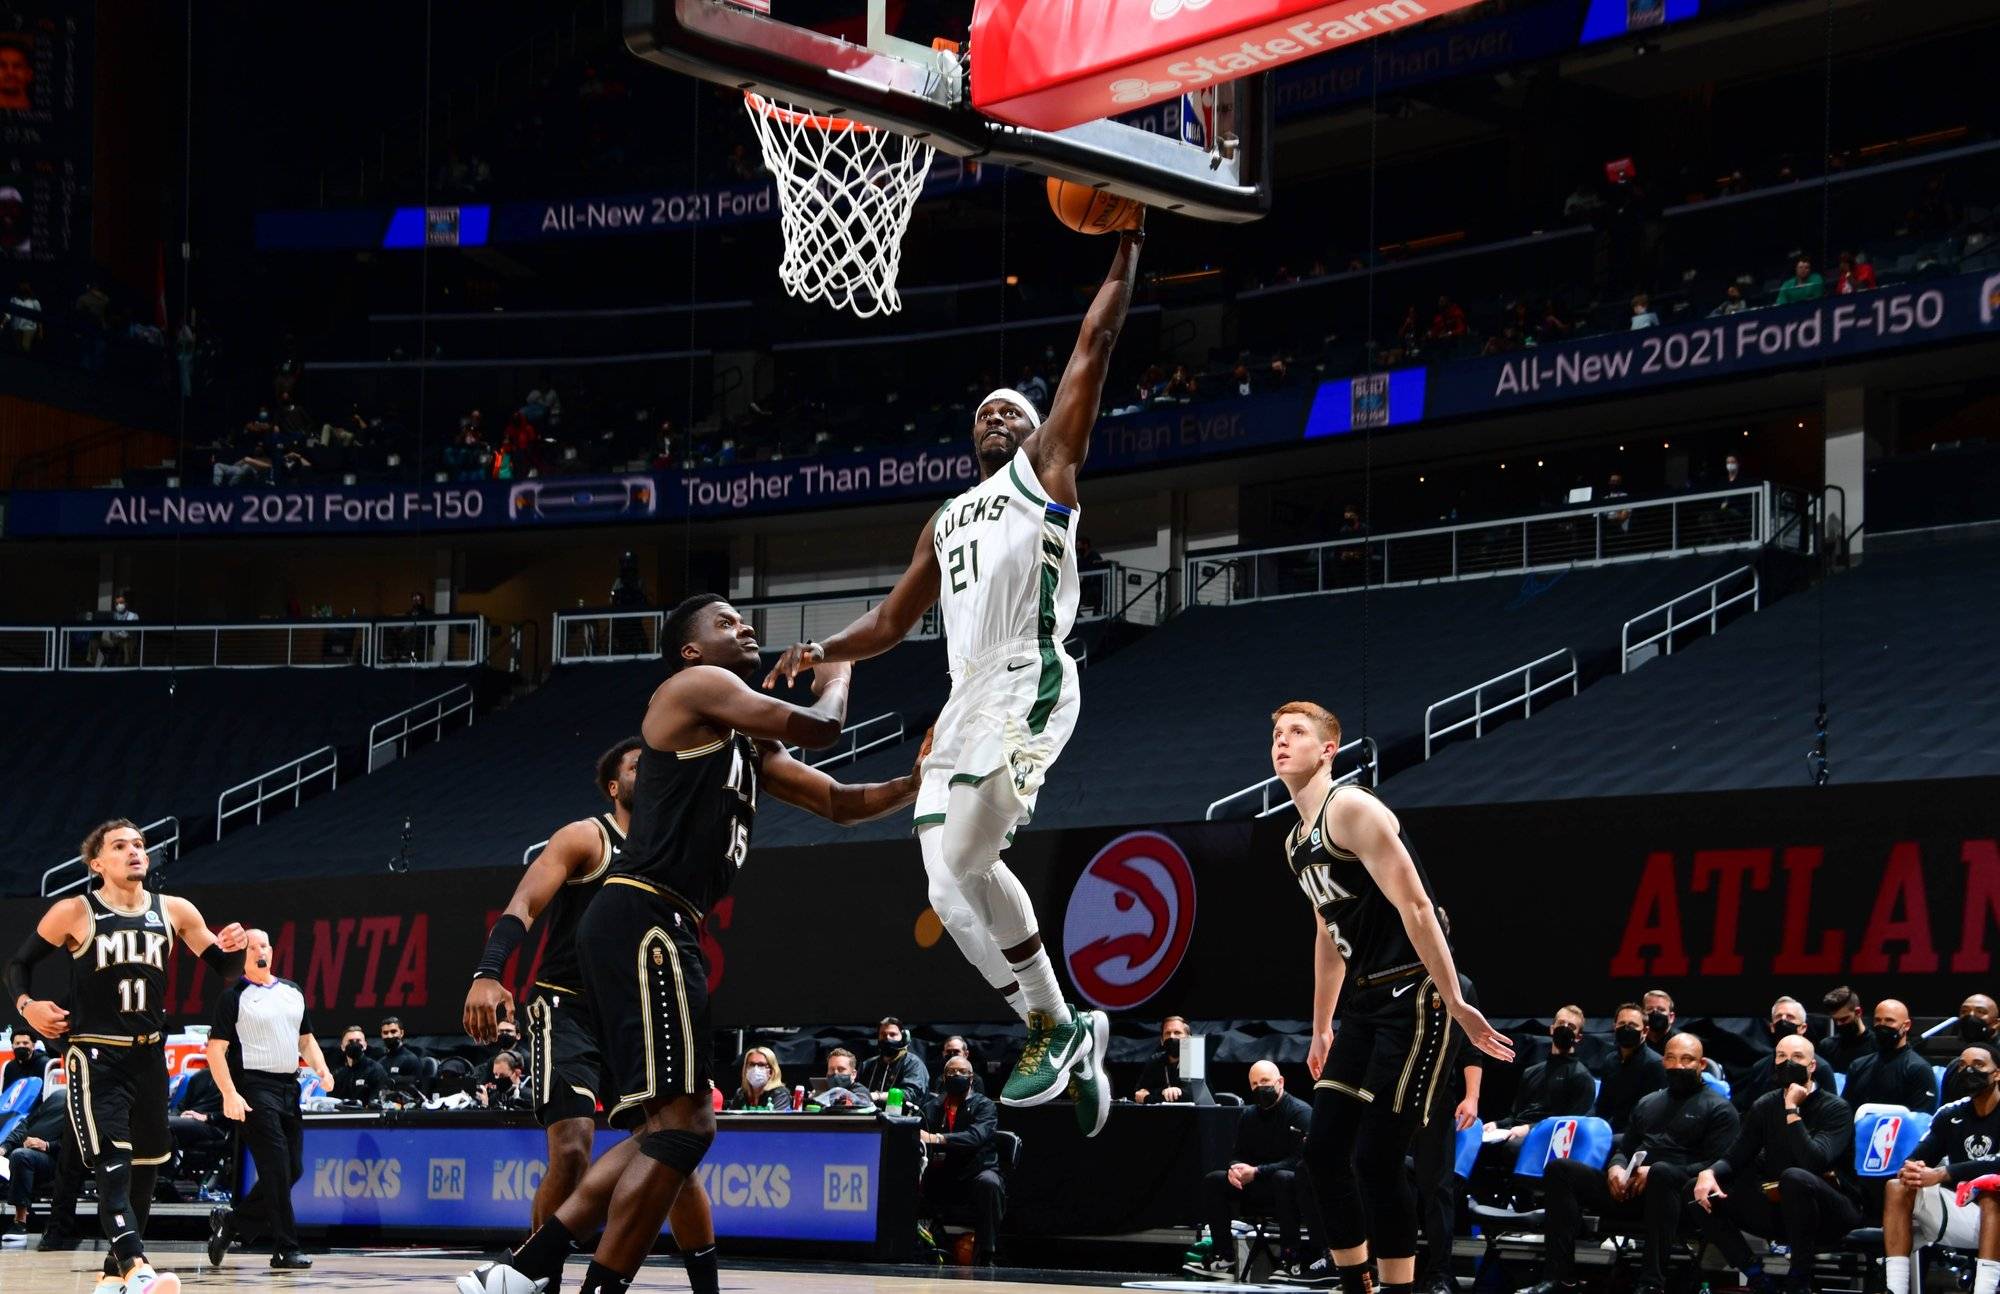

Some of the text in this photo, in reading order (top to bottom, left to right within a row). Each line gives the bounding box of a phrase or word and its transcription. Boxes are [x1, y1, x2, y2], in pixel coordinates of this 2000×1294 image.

[541, 203, 644, 232] All-New
[650, 197, 710, 225] 2021
[718, 185, 771, 218] Ford
[1495, 289, 1945, 397] All-New 2021 Ford F-150
[1101, 423, 1173, 457] Than
[681, 453, 978, 509] Tougher Than Before.
[105, 489, 484, 526] All-New 2021 Ford F-150
[935, 495, 1010, 552] BUCKS
[949, 539, 979, 595] 21
[724, 815, 749, 870] 15
[94, 929, 168, 972] MLK
[118, 978, 148, 1013] 11
[314, 1158, 401, 1199] KICKS
[491, 1158, 547, 1200] KIC
